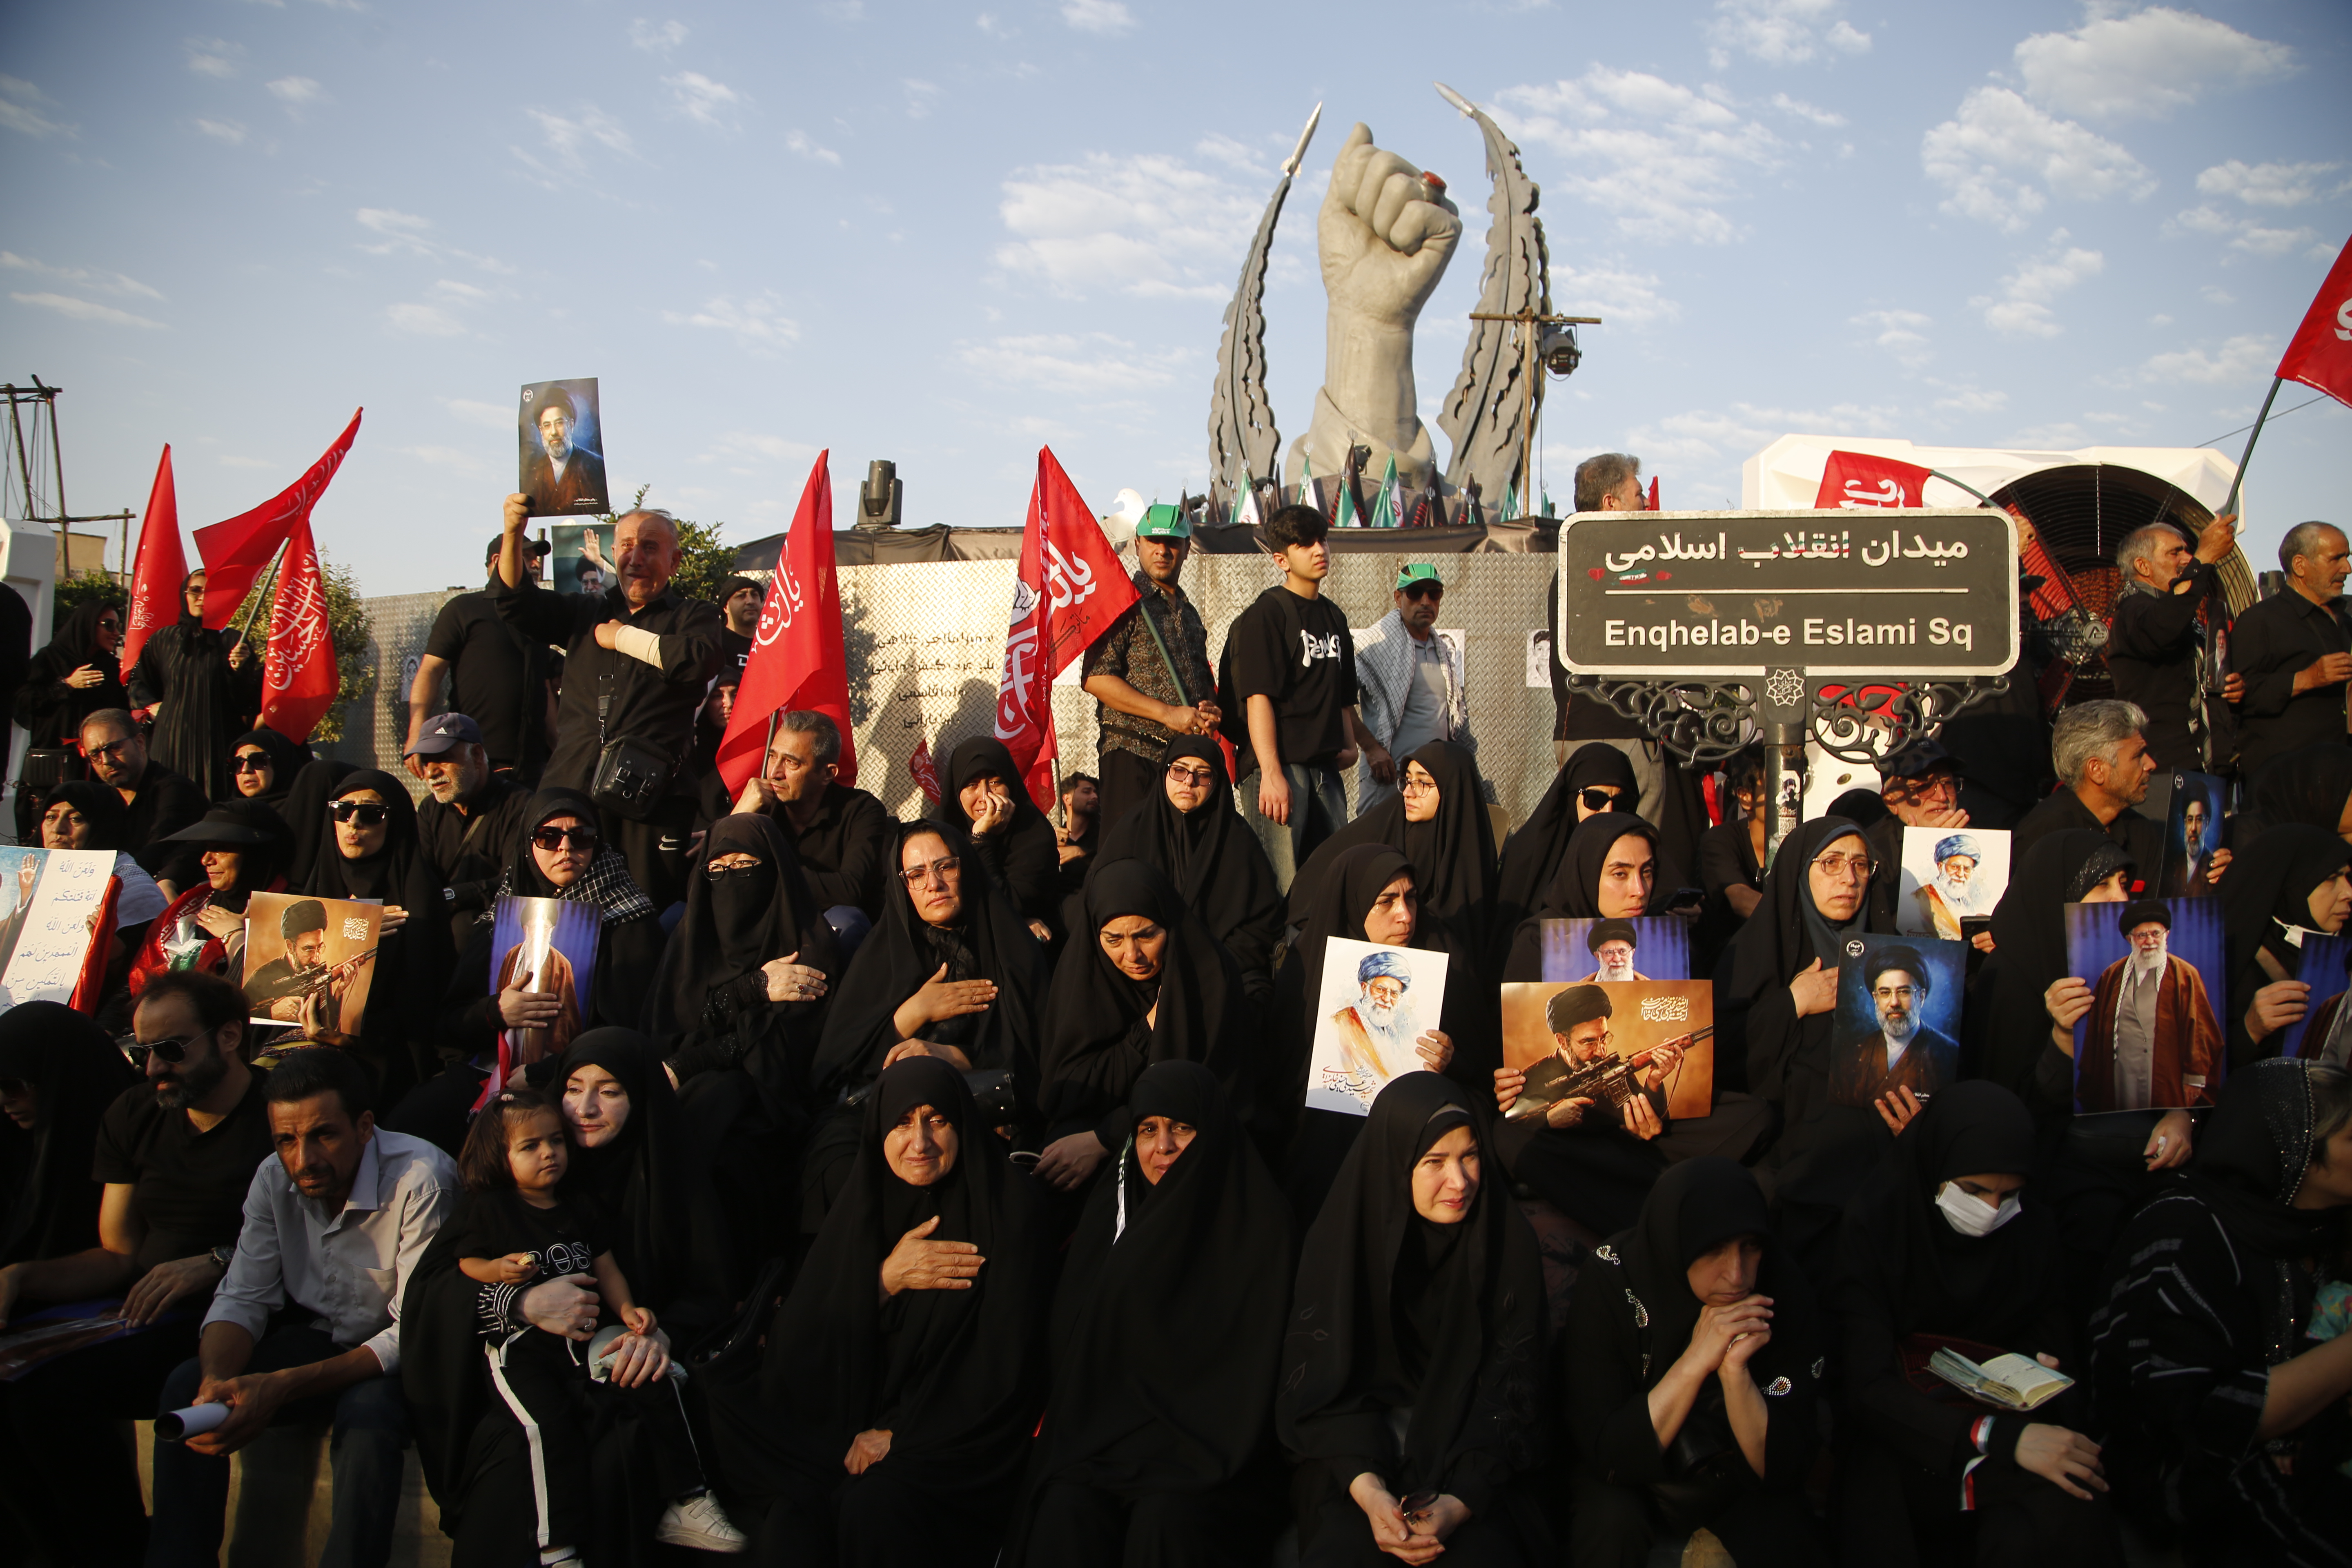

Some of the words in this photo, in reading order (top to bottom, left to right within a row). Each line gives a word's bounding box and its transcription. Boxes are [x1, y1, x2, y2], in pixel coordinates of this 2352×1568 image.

[1605, 532, 1726, 572] اسلامی
[1738, 530, 1849, 568] انقلاب
[1861, 530, 1968, 567] میدان
[1605, 619, 1791, 653] Enqhelab-e
[1804, 618, 1916, 645] Eslami
[1929, 617, 1972, 652] Sq
